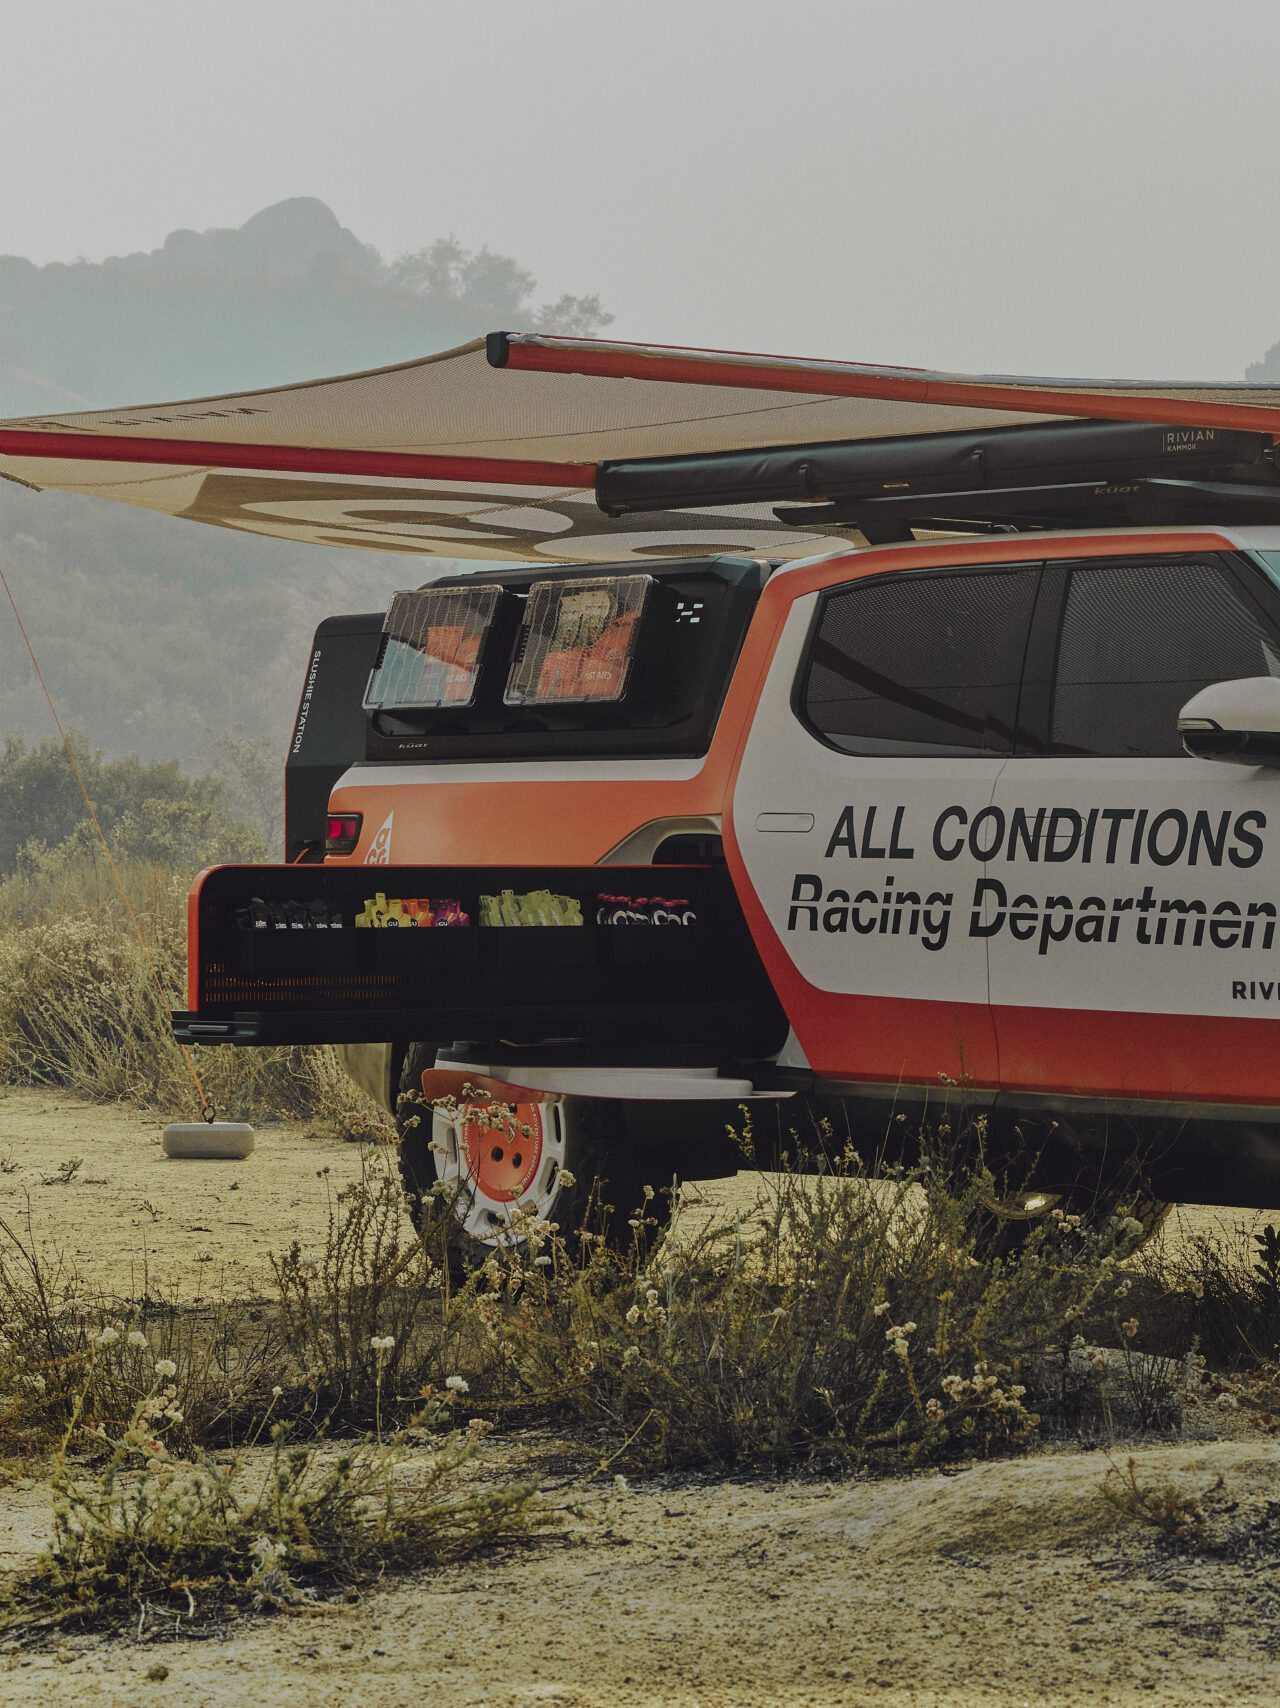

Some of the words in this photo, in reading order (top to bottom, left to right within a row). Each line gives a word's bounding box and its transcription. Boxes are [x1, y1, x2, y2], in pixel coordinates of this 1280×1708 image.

[1167, 430, 1214, 443] RIVIAN
[304, 650, 321, 700] SLUSHIE
[293, 702, 310, 753] STATION
[824, 805, 915, 859] ALL
[932, 805, 1267, 868] CONDITIONS
[787, 873, 953, 951] Racing
